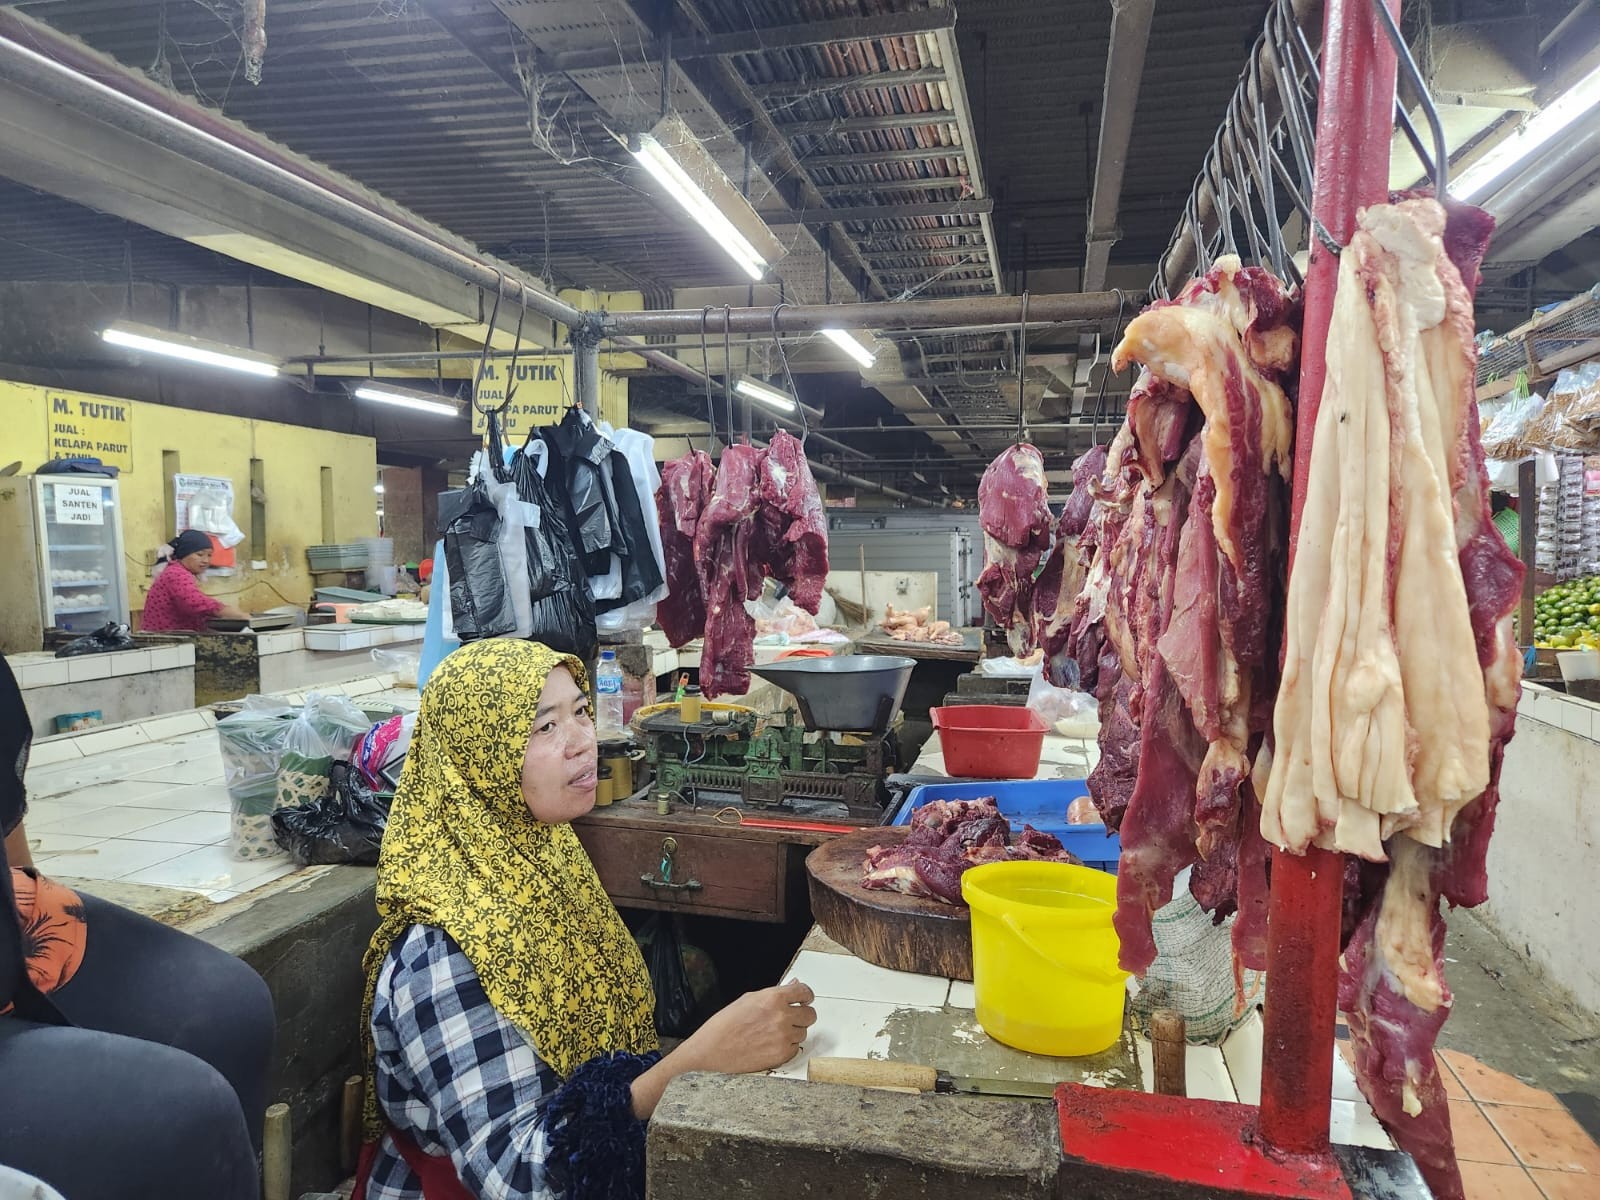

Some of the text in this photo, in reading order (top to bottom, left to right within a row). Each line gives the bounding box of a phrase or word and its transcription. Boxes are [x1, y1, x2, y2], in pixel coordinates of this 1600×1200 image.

[480, 365, 499, 380] M.
[479, 390, 504, 400] JUAL
[53, 398, 126, 421] M. TUTIK
[523, 405, 559, 415] PARUT
[54, 424, 79, 435] JUAL
[54, 438, 128, 454] KELAPA PARUT
[69, 488, 91, 497] JUAL
[62, 500, 98, 510] SANTEN
[71, 513, 91, 521] JADI
